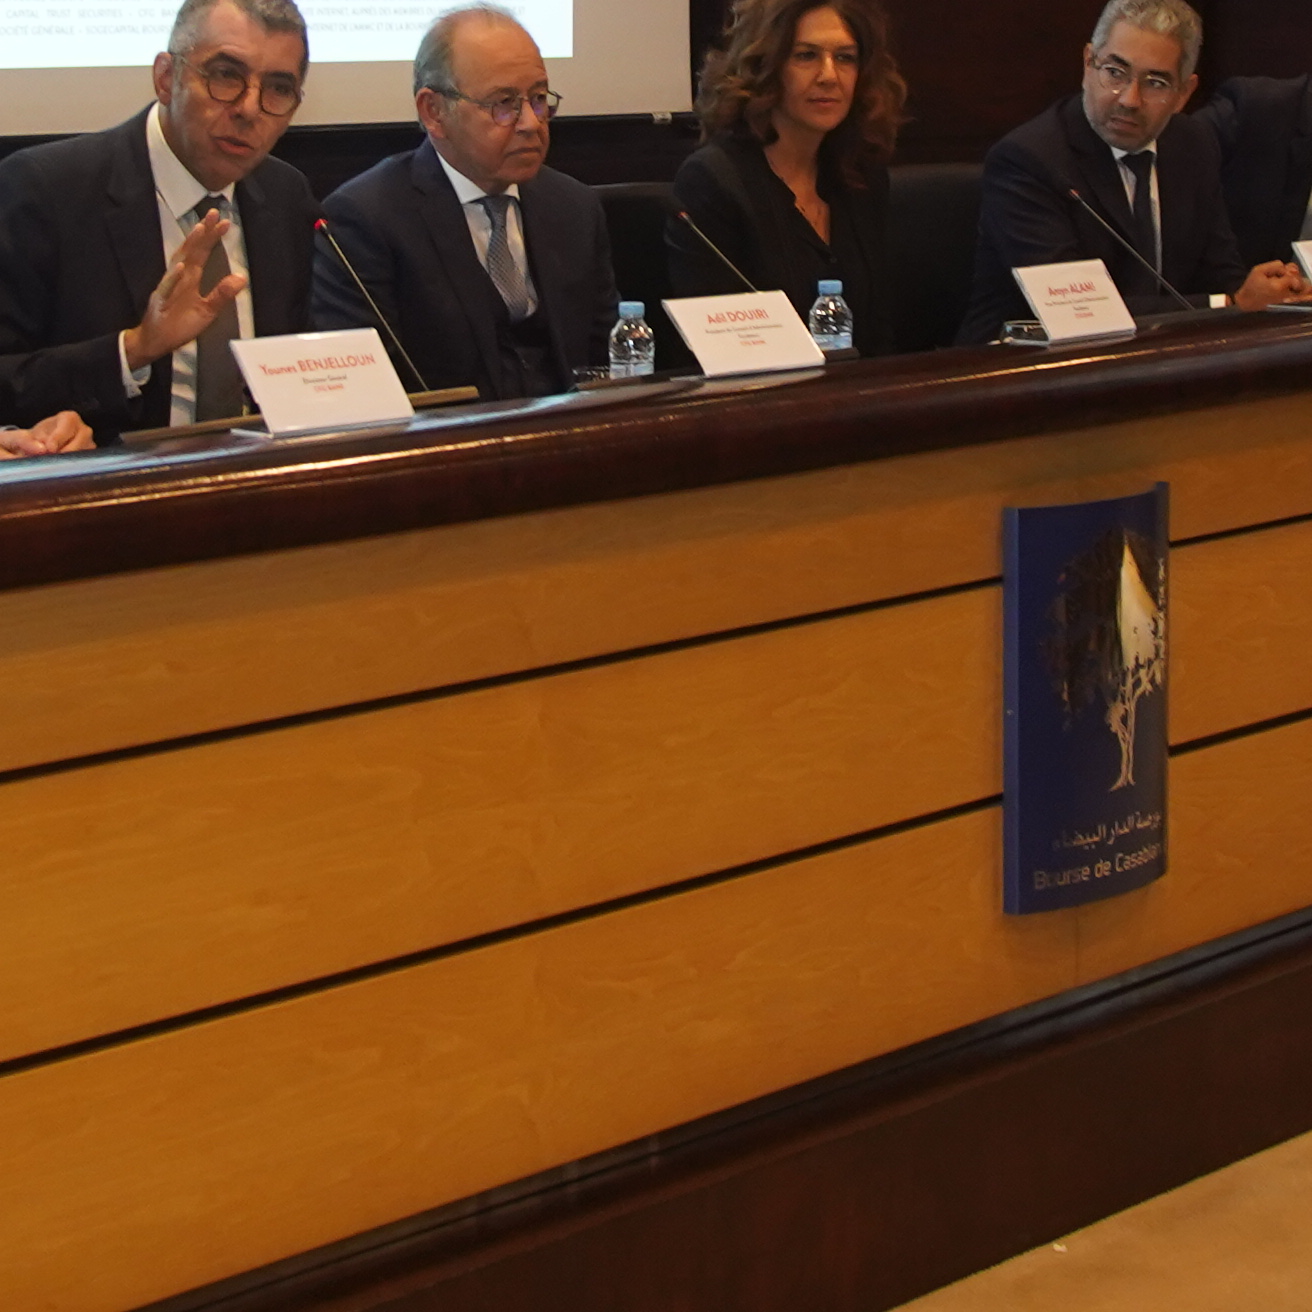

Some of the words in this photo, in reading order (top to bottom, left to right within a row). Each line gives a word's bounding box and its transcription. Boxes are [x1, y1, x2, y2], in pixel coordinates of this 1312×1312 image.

[727, 308, 769, 323] DOUIRI
[297, 353, 376, 372] BENJELLOUN
[1094, 858, 1112, 878] de
